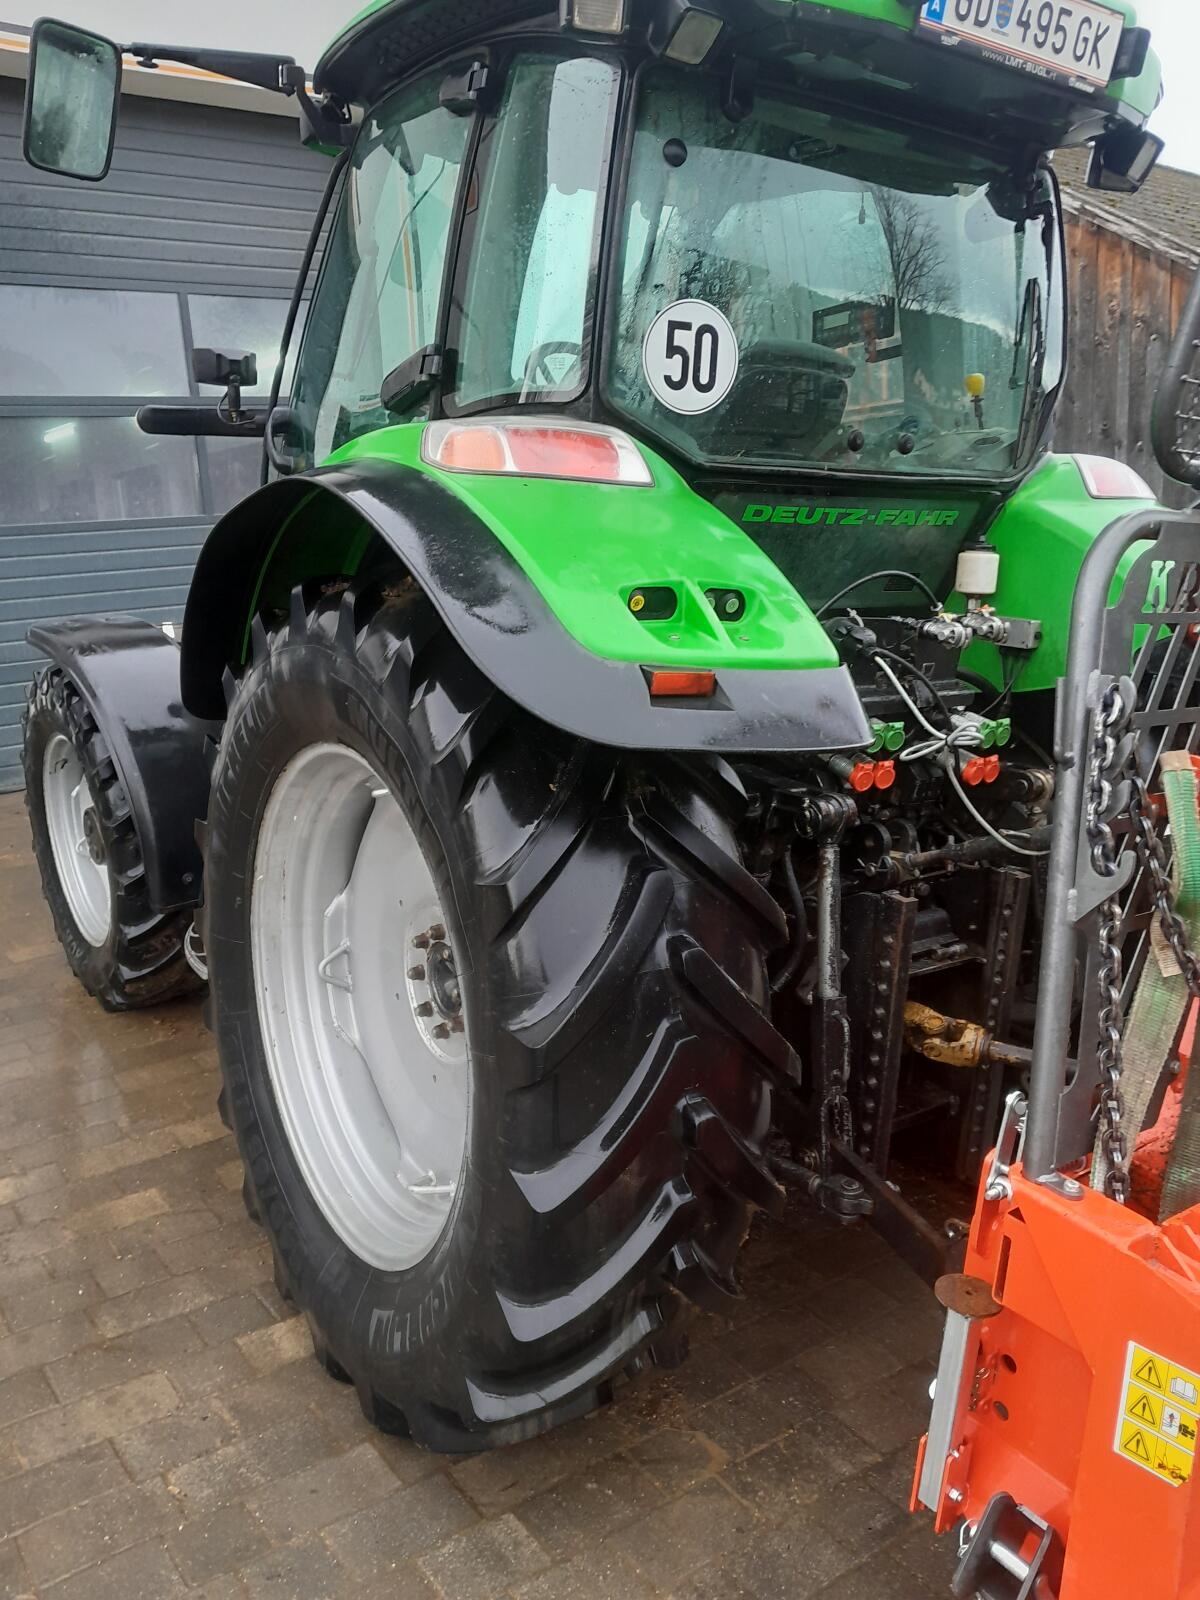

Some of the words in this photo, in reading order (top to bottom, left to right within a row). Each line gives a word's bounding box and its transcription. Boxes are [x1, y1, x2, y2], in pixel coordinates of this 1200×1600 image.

[931, 0, 940, 13] A
[1016, 0, 1073, 54] 495
[663, 319, 719, 394] 50
[741, 504, 959, 526] DEUTZ-FAHR
